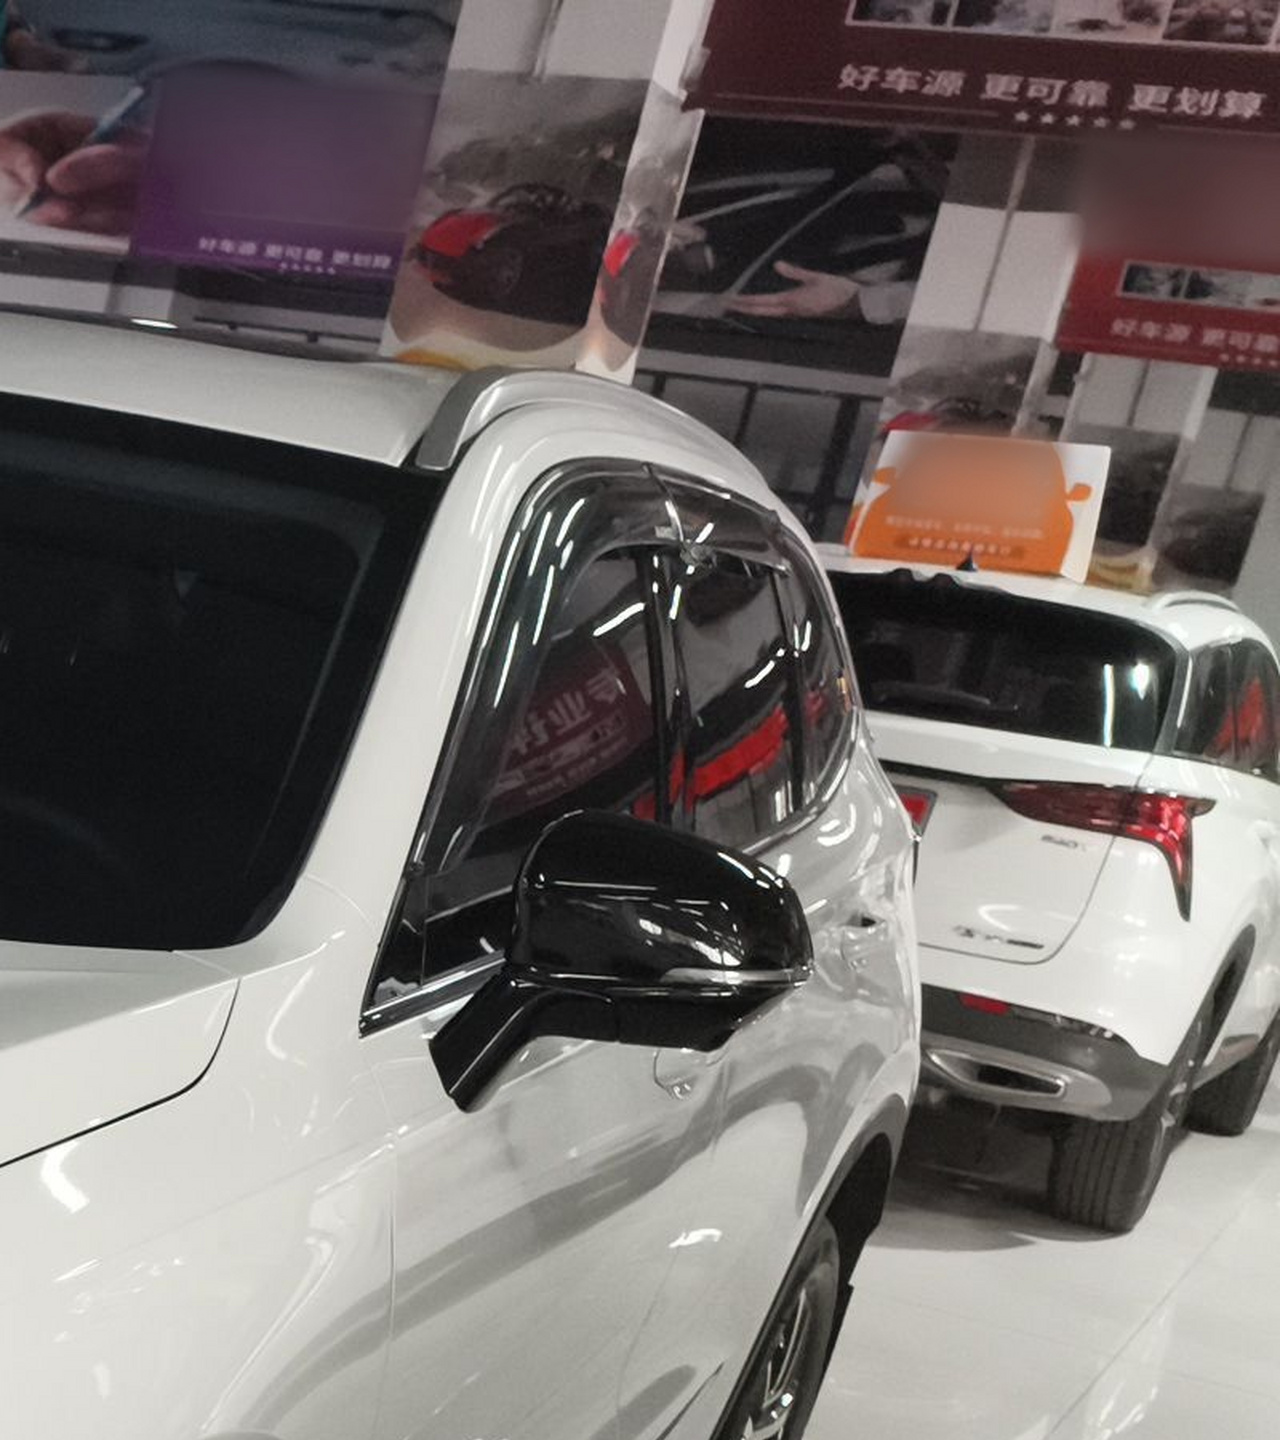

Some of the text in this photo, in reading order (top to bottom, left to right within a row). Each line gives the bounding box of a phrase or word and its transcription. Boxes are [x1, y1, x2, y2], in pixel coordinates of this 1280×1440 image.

[838, 63, 1268, 119] 好车源 更可靠 更划算
